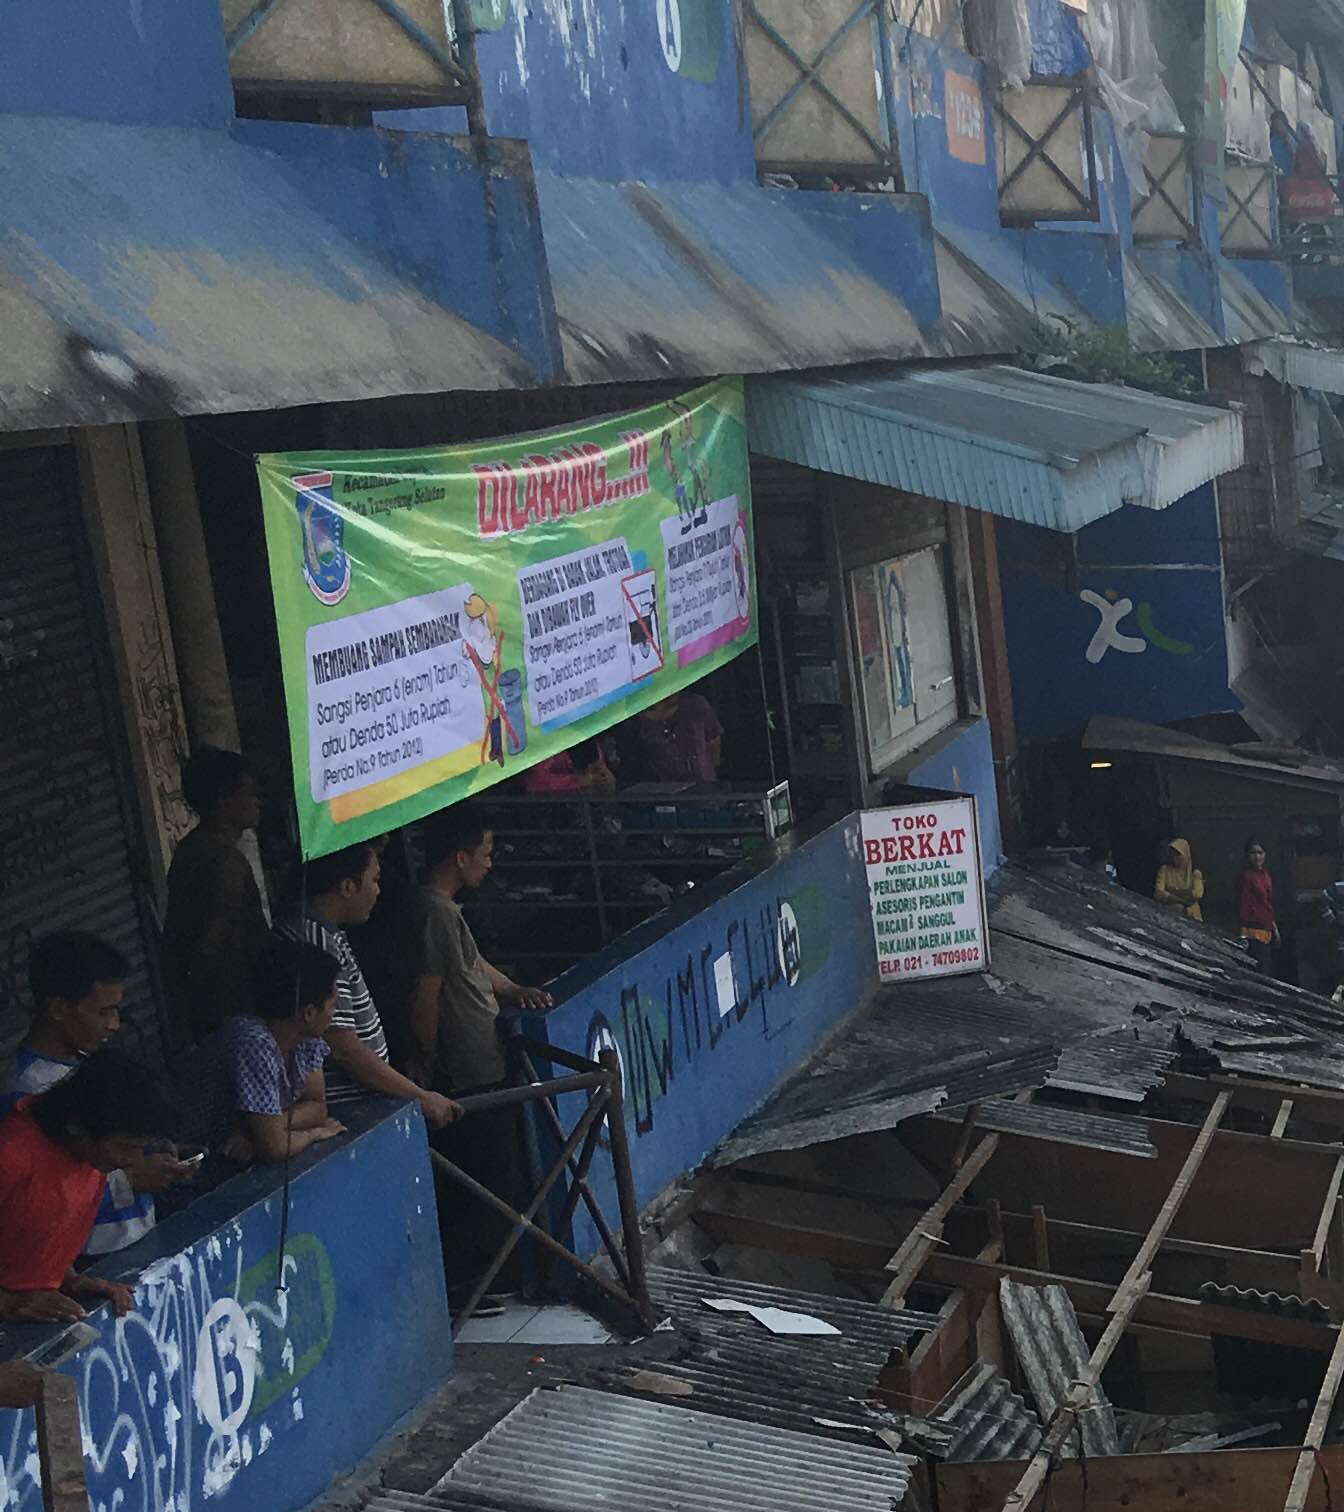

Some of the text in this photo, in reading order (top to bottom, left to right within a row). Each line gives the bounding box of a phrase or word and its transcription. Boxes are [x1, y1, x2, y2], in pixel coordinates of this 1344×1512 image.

[312, 641, 370, 685] MEMBUANG
[370, 629, 407, 668] SAMPAH
[316, 662, 458, 726] Sangsi Penjara 6 (enam) Tahun
[321, 697, 452, 758] atau Denda 50 Juta Rupiah
[377, 747, 400, 769] Tahun
[892, 814, 938, 831] TOKO
[864, 828, 966, 865] BERKAT
[886, 860, 951, 875] MENJUAL
[874, 870, 968, 896] PERLENGKAPAN SALON
[876, 891, 965, 916] ASESORIS PENGANTIN
[917, 911, 956, 930] SANGGUL
[879, 928, 977, 955] PAKAIAN DAERAH ANAK
[904, 957, 923, 972] 021
[932, 947, 979, 967] 74709802
